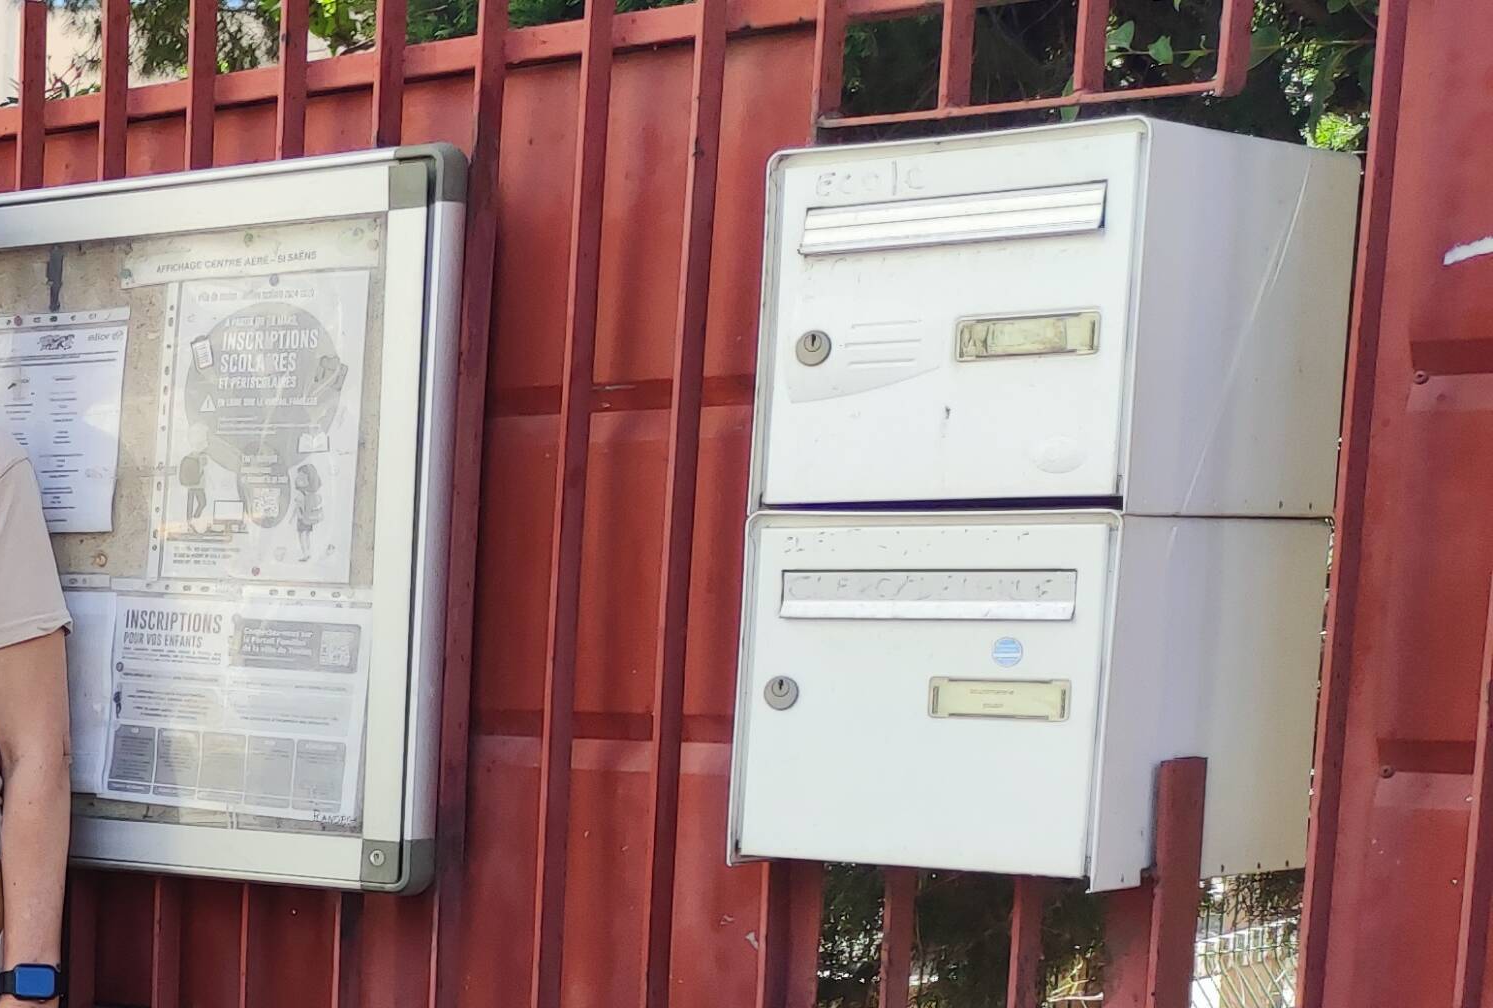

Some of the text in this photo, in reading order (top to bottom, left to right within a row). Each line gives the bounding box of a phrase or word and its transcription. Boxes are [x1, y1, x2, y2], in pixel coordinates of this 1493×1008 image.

[156, 260, 203, 273] AFFICHAGE
[204, 257, 243, 269] CENTRE
[220, 352, 297, 373] SCOLARES
[125, 608, 223, 635] INSCRIPTIONS
[123, 631, 203, 648] POUR VOS ENFANTS
